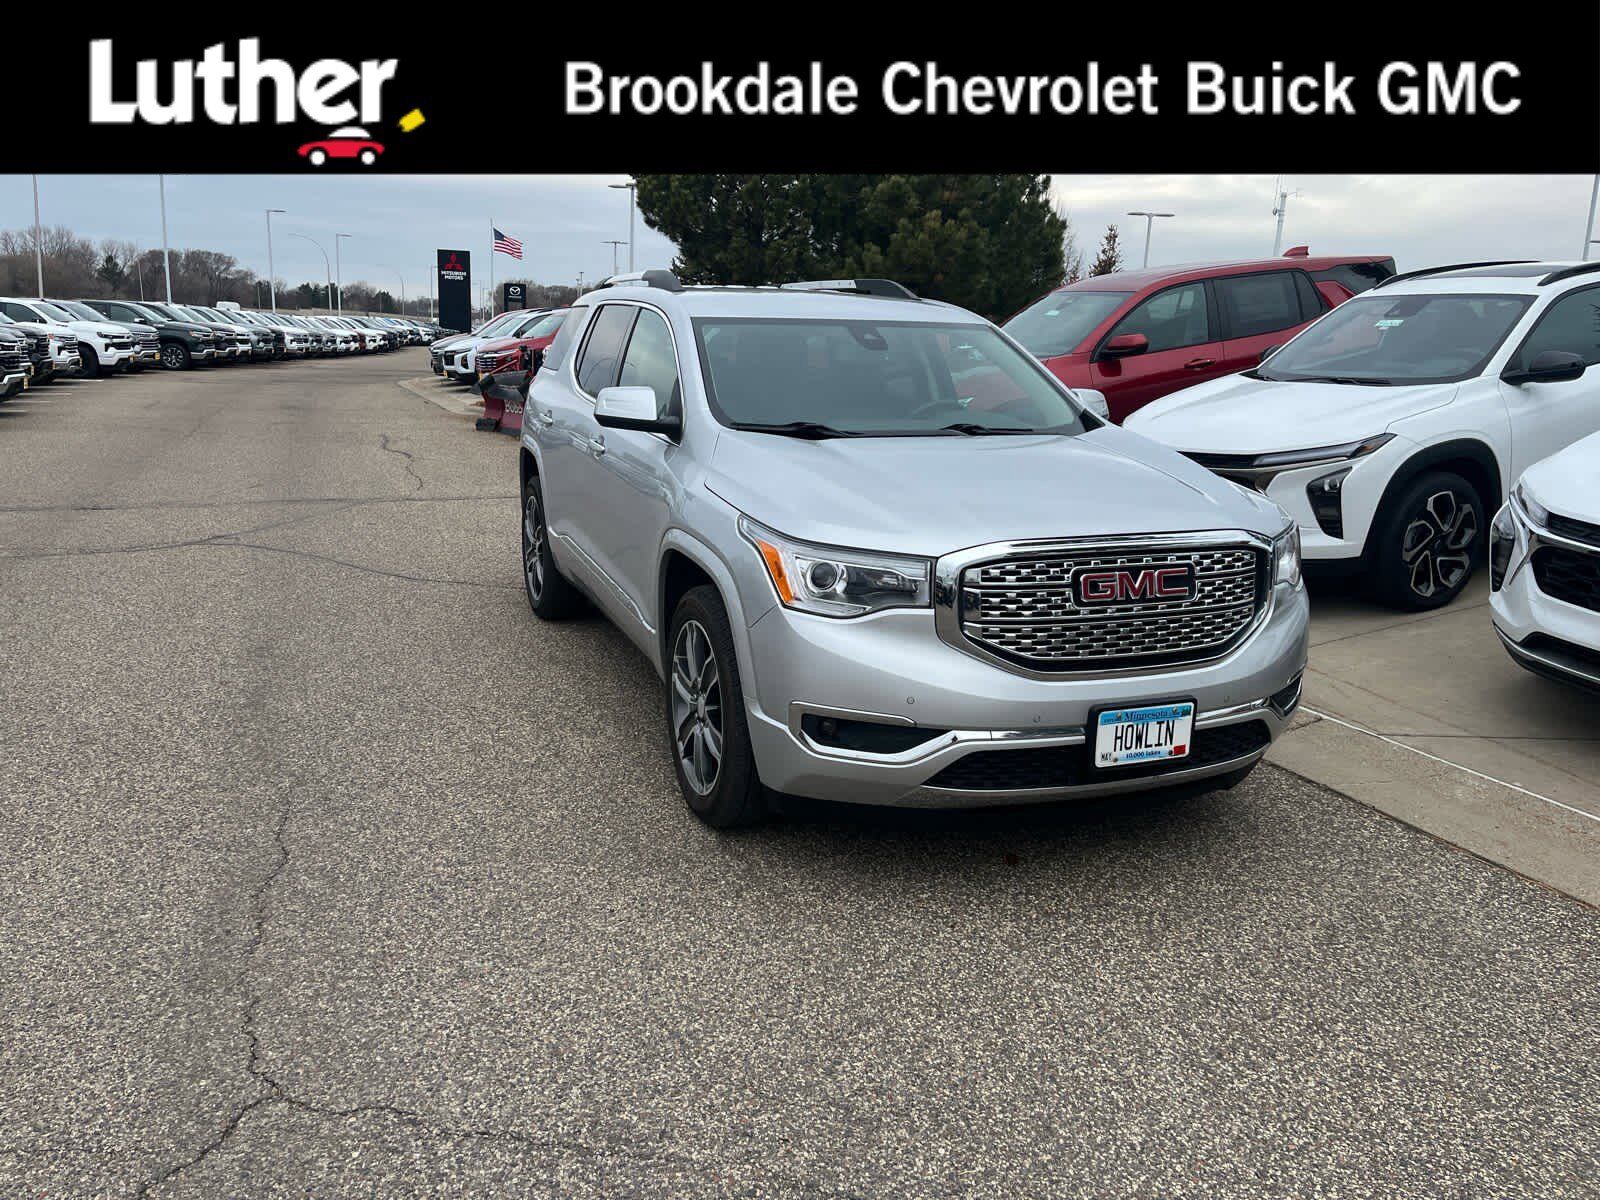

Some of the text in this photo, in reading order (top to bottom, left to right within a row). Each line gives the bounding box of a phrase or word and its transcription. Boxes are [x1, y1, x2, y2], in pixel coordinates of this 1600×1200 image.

[1080, 567, 1189, 602] GMC
[1125, 710, 1168, 722] Minnesota
[1113, 720, 1175, 752] HOWLIN
